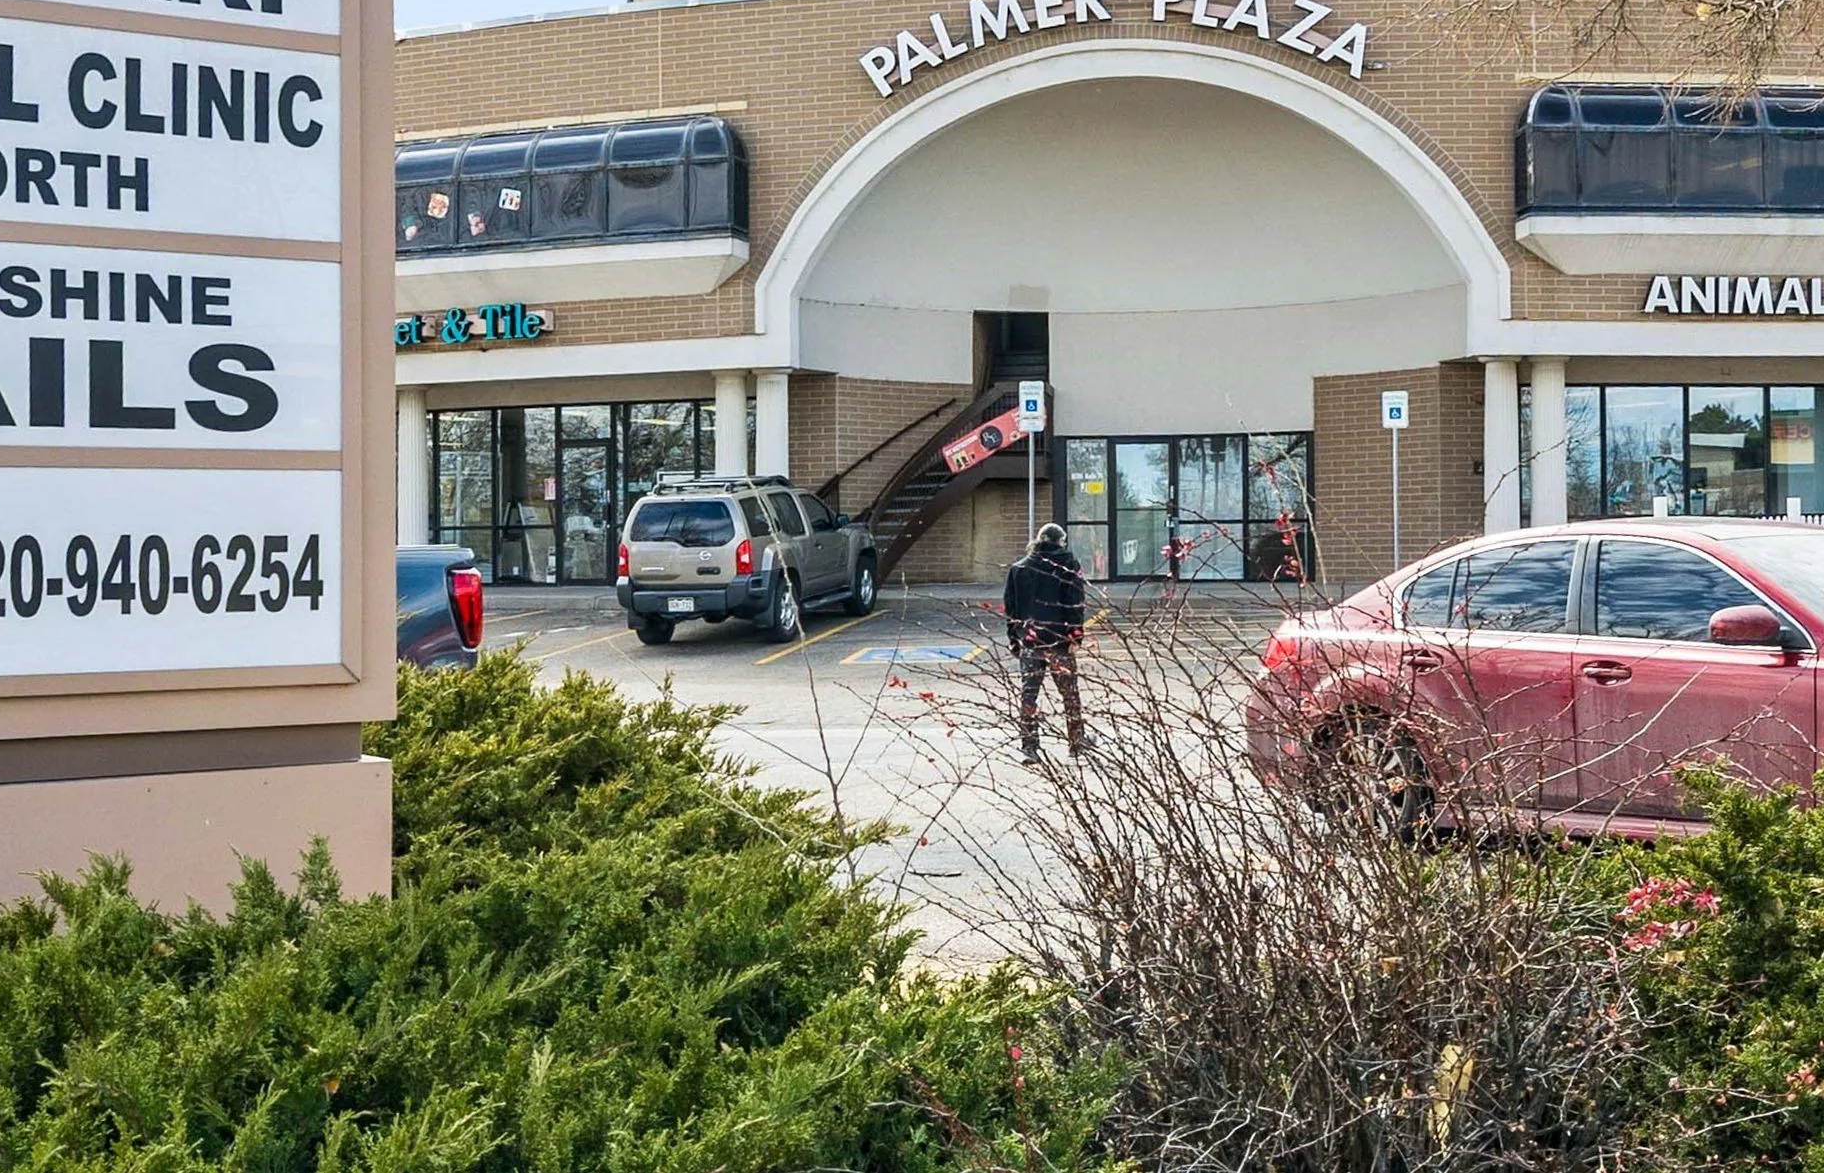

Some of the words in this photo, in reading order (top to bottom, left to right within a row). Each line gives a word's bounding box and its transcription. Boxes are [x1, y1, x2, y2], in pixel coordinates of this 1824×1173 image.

[68, 52, 324, 148] CLINIC
[440, 307, 471, 344] &
[479, 302, 541, 340] Tile
